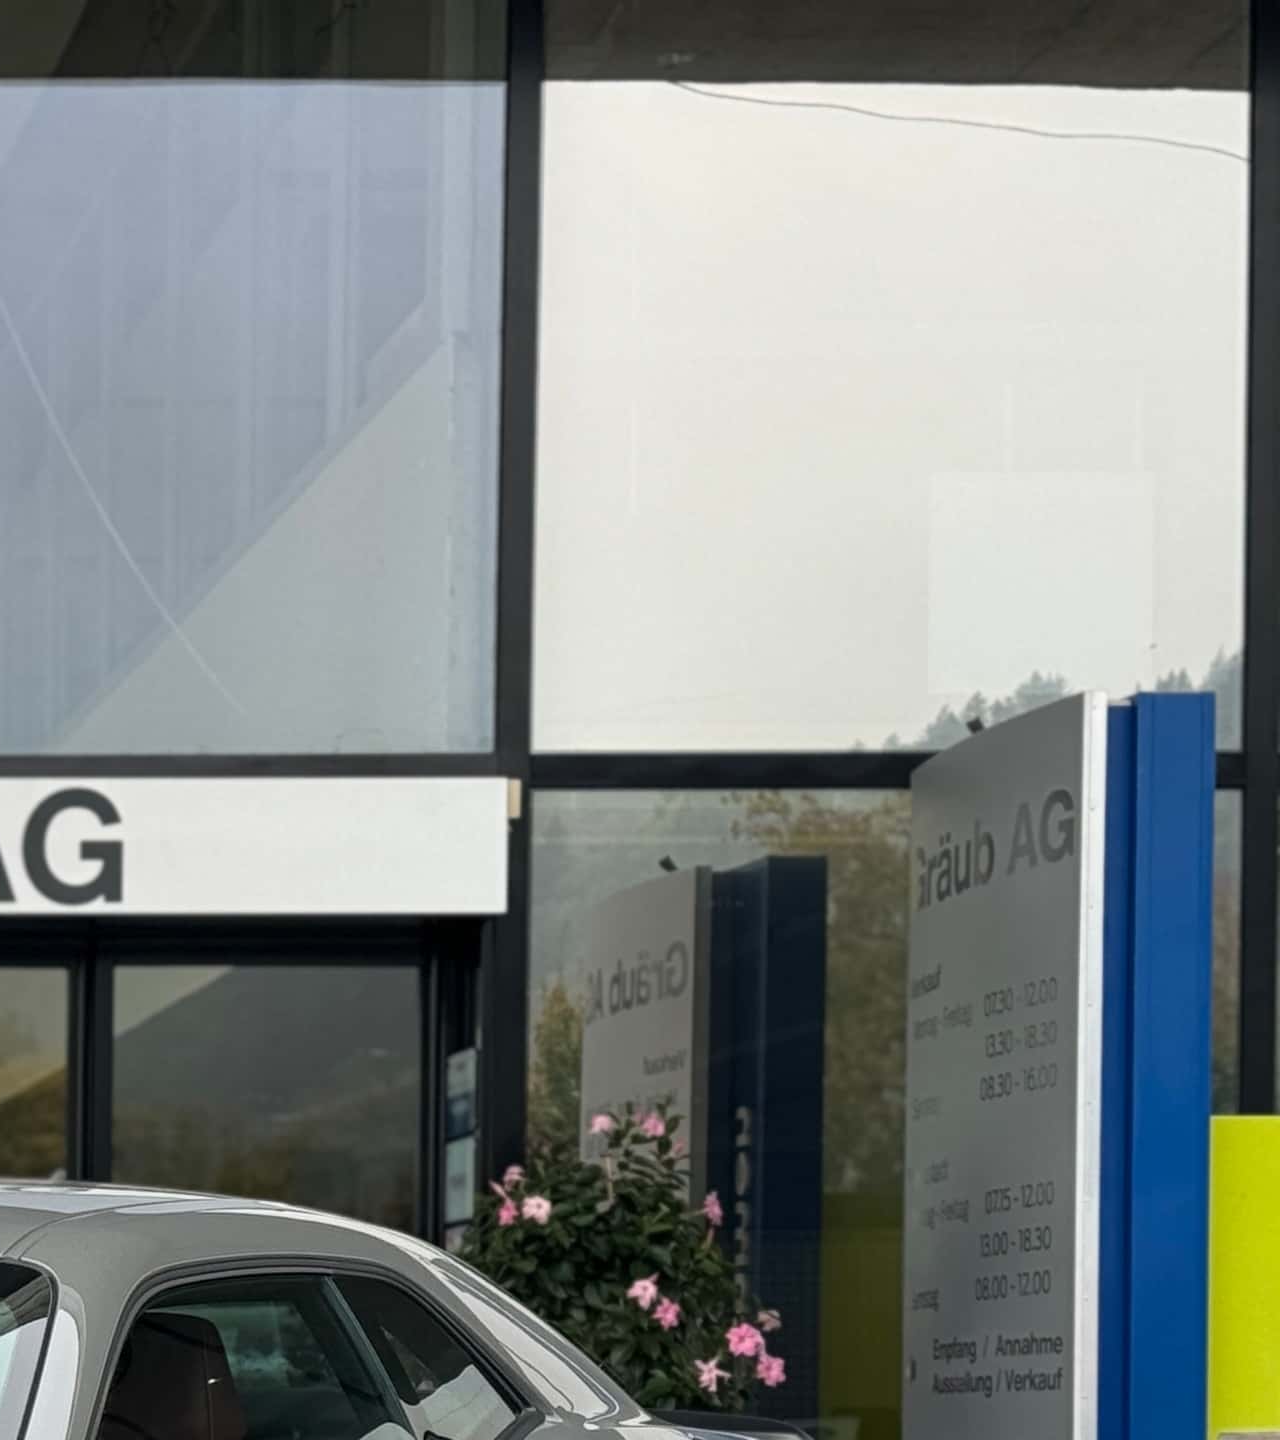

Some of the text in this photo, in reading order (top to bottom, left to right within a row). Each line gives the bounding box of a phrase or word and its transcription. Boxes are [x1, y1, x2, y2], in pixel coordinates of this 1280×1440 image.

[1006, 788, 1076, 876] AG
[1024, 977, 1057, 1007] 12.00
[979, 1071, 1012, 1102] 08.30
[1020, 1181, 1055, 1208] 12.00
[979, 1232, 1009, 1259] 13.00
[1017, 1226, 1053, 1253] 18.30
[975, 1275, 1008, 1302] 08.00
[1017, 1270, 1052, 1297] 12.00
[933, 1336, 977, 1364] Empfang
[995, 1331, 1063, 1357] Annahme
[1005, 1367, 1063, 1392] Verkauf
